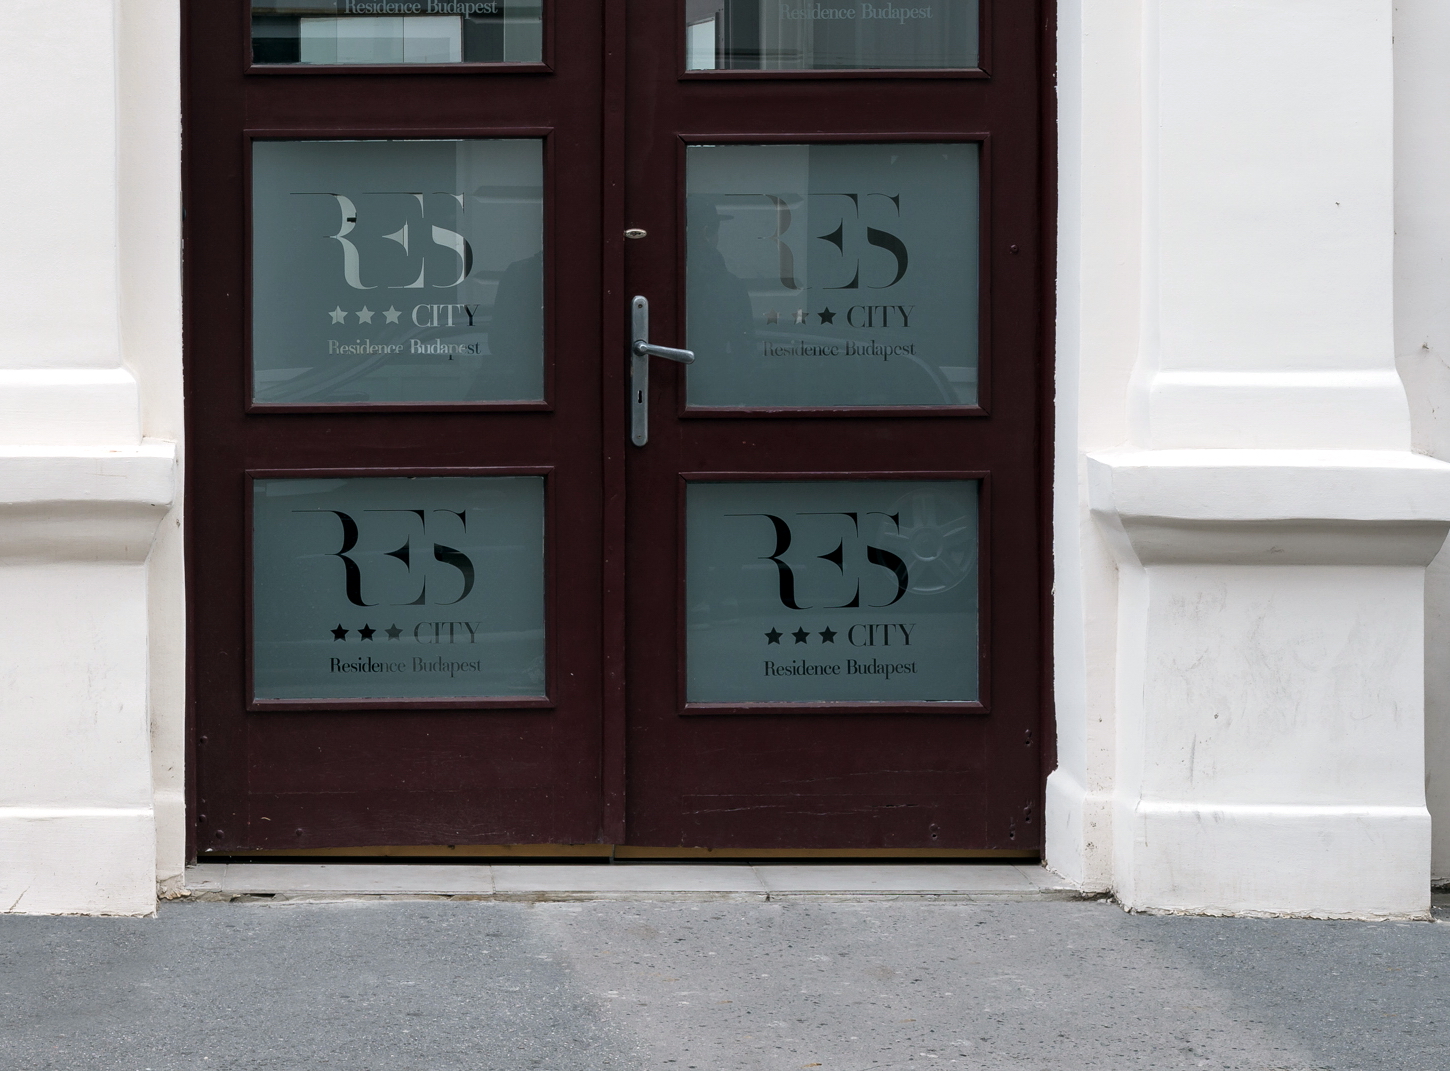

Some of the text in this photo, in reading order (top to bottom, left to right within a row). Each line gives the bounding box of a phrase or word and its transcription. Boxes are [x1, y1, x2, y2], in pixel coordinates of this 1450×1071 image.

[779, 2, 933, 24] Residence Budapest
[290, 191, 474, 290] RES
[724, 192, 909, 290] RES
[411, 304, 481, 327] CITY
[846, 305, 916, 328] CITY
[327, 339, 482, 360] Residence Budapest
[762, 340, 917, 361] Residence Budapest
[291, 509, 475, 607] RES
[724, 512, 909, 610] RES
[413, 621, 483, 645] CITY
[848, 623, 917, 647] CITY
[329, 656, 482, 678] Residence Budapest
[763, 658, 918, 679] Residence Budapest
